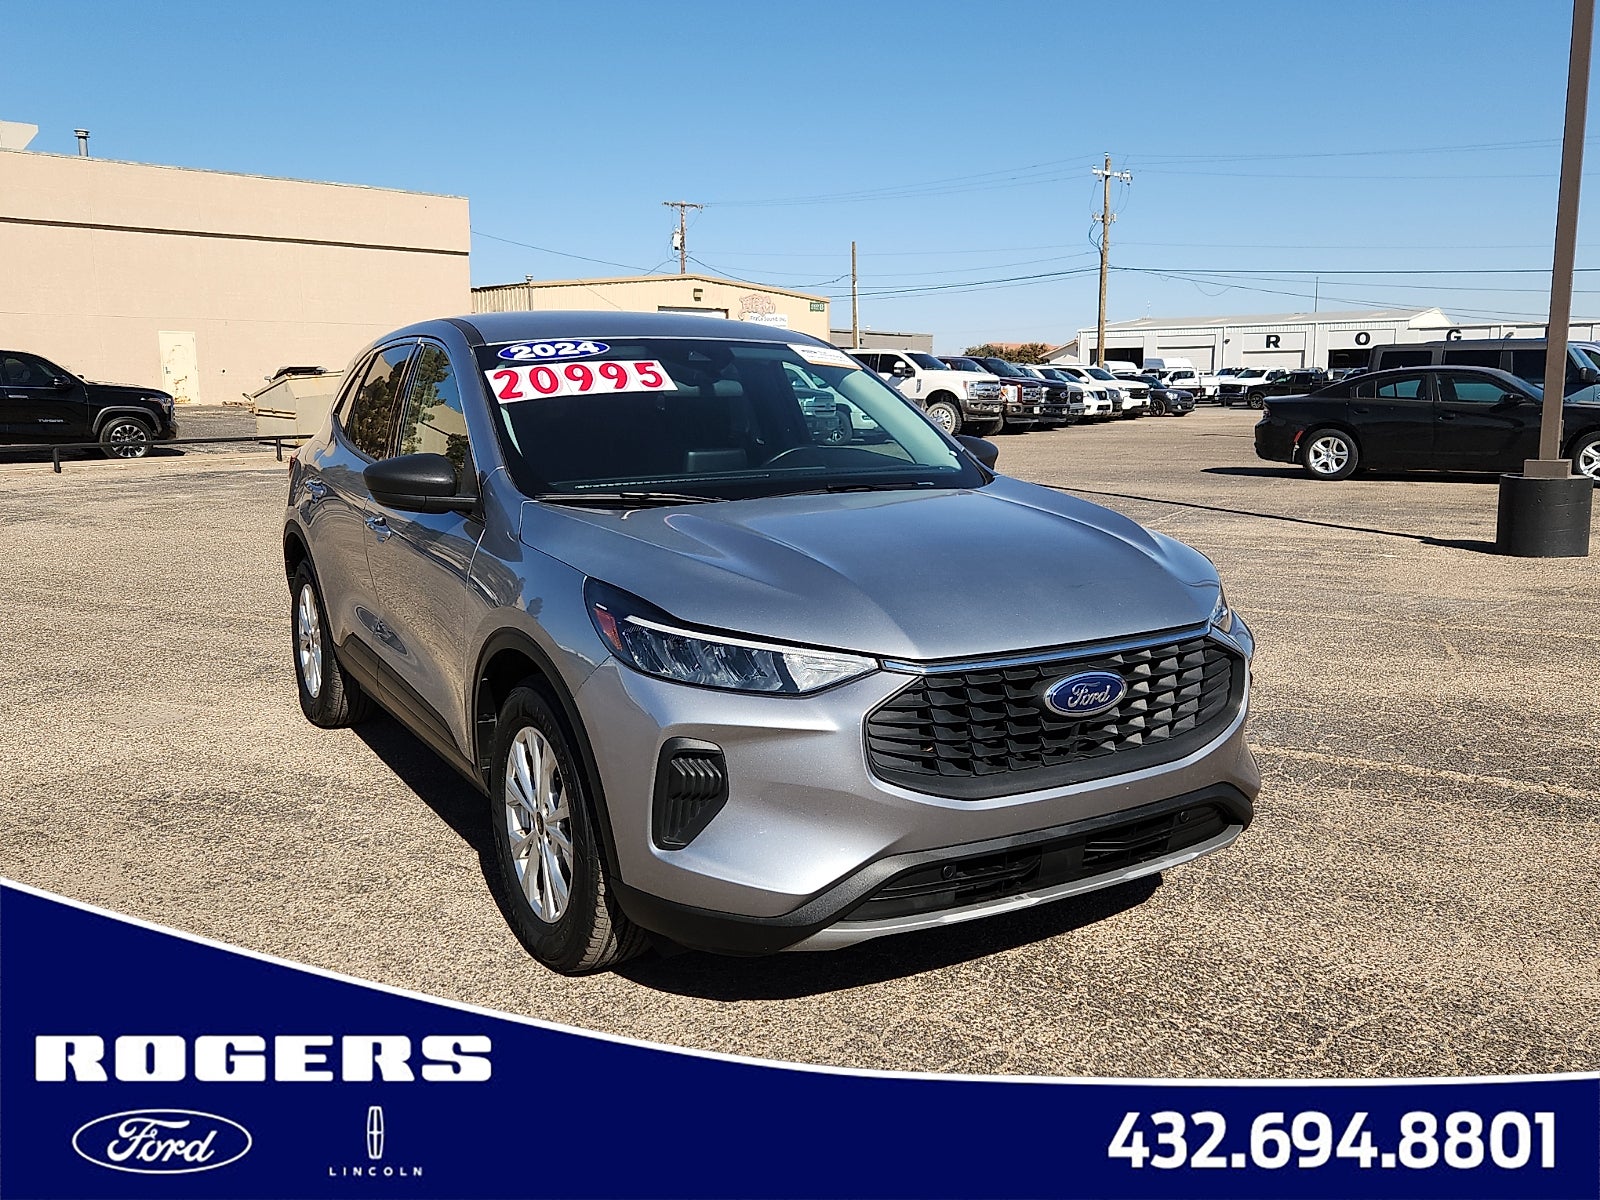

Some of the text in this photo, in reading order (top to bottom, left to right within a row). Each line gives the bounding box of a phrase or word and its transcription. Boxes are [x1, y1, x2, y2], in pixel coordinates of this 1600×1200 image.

[510, 342, 600, 359] 2024
[493, 362, 663, 399] 20995
[1067, 681, 1111, 708] Ford
